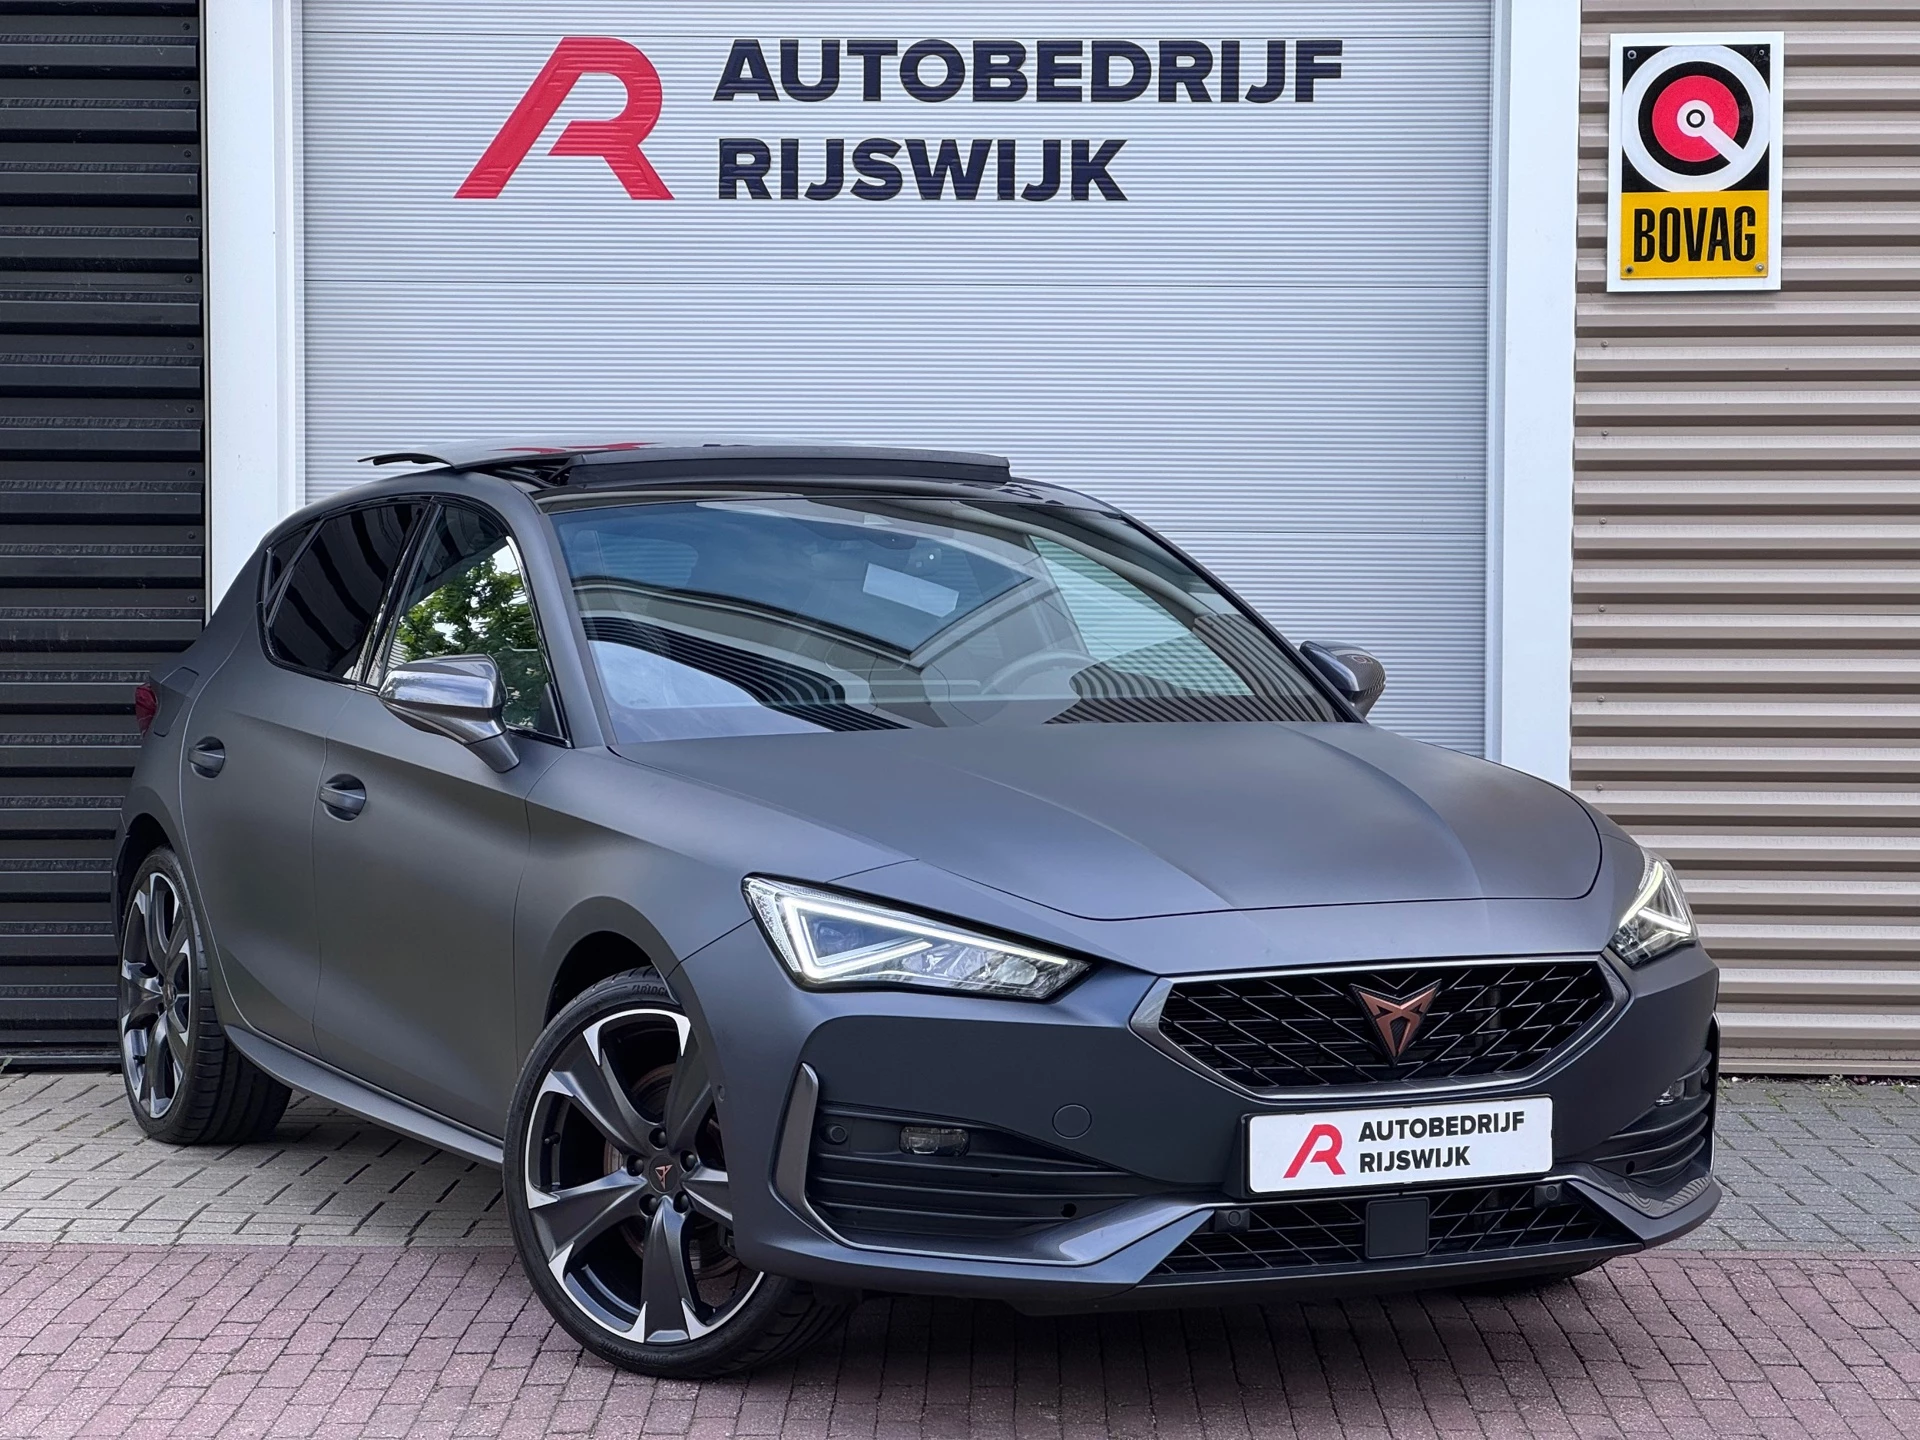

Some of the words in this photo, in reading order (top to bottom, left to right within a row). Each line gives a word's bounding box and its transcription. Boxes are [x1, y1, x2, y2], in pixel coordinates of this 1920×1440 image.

[712, 38, 1343, 103] AUTOBEDRIJF
[718, 138, 1128, 202] RIJSWIJK
[1633, 206, 1756, 263] BOVAG
[1358, 1111, 1525, 1142] AUTOBEDRIJF
[1359, 1146, 1471, 1174] RIJSWIJK
